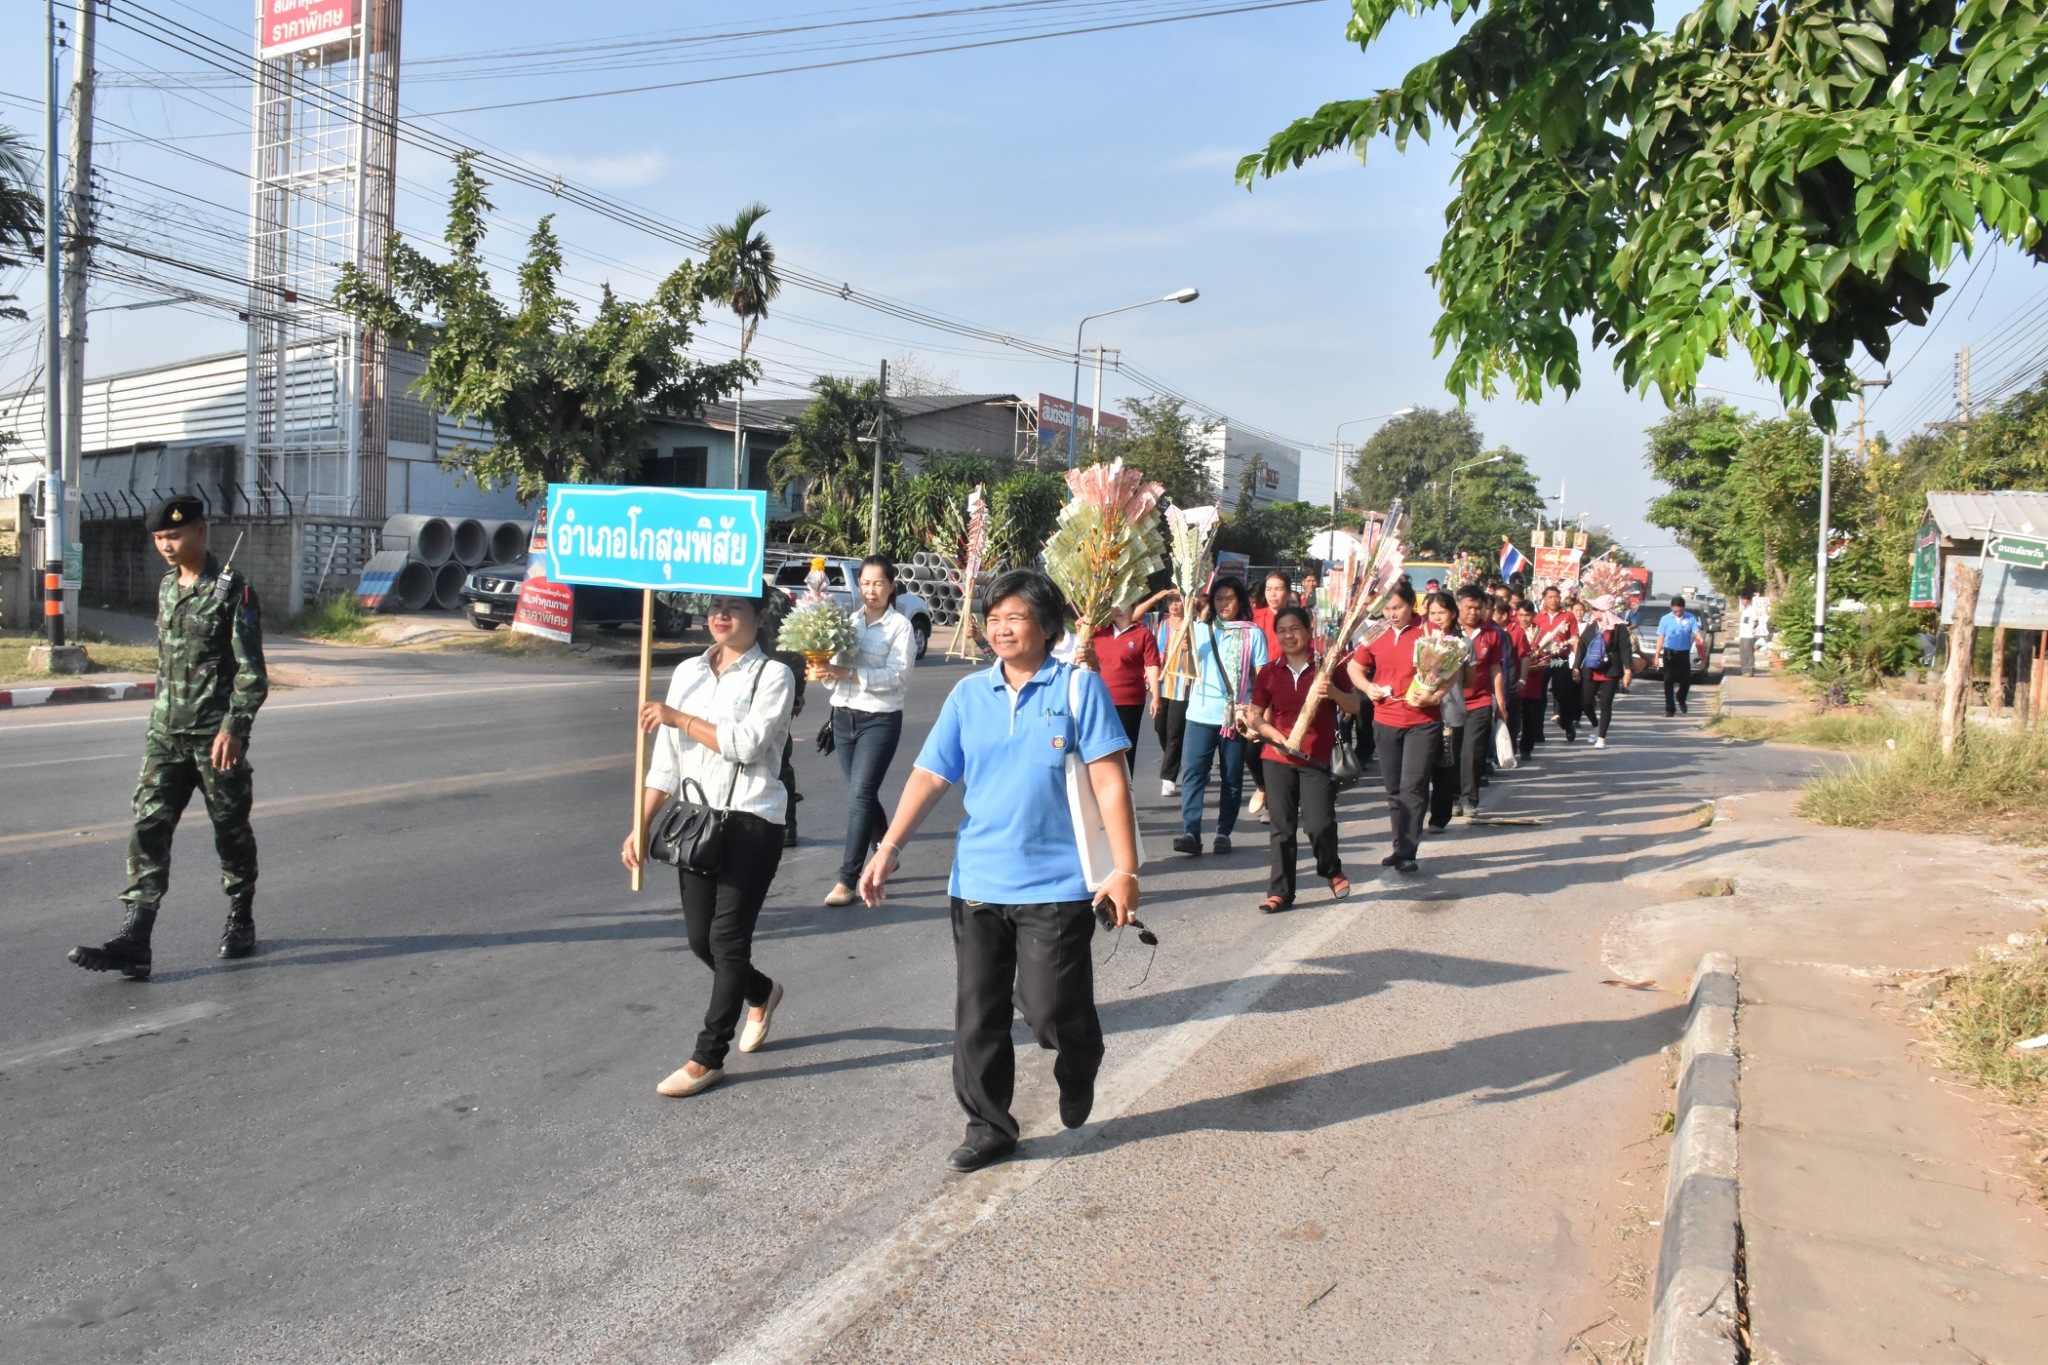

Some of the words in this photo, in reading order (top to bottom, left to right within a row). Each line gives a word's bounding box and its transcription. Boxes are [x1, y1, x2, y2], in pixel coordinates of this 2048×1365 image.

[272, 8, 343, 42] ราคาพิเศษ
[558, 506, 747, 580] อำเภอโกสุมพิสัย
[522, 593, 569, 611] สินค้าคุณภาพ
[519, 608, 568, 627] ราคาพิเศษ
